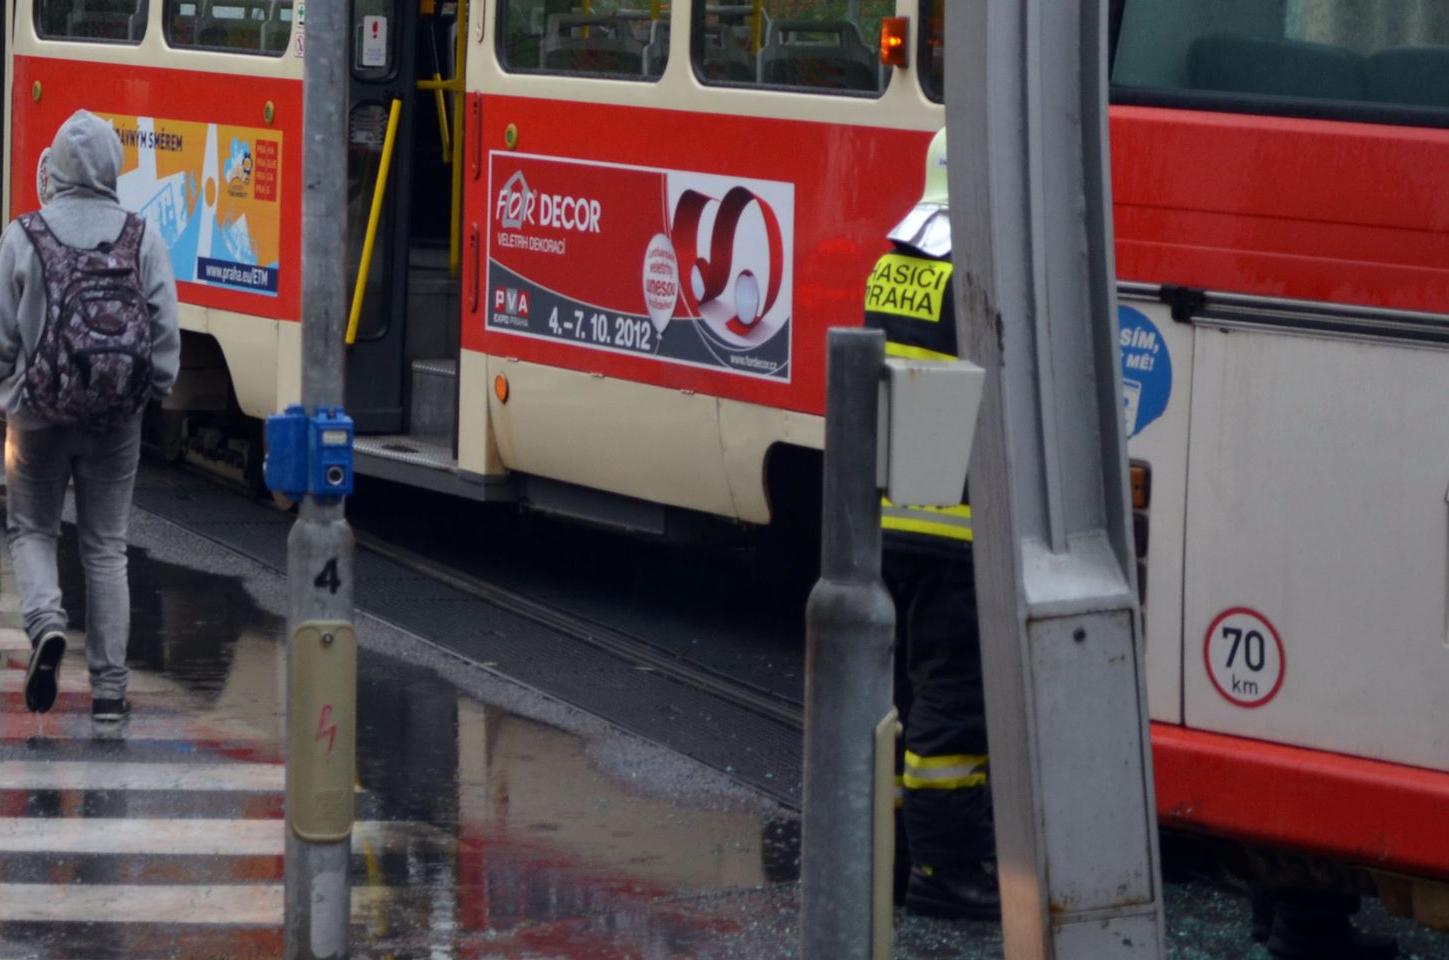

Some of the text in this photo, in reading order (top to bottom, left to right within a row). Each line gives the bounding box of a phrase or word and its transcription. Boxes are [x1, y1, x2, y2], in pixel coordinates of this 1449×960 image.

[496, 189, 601, 234] FOR DECOR
[497, 232, 566, 255] VELETRH DEKORACÍ
[872, 263, 945, 291] HASIČI
[495, 290, 529, 314] PVA
[865, 283, 934, 316] PRAHA
[590, 312, 611, 344] 10.
[614, 316, 651, 351] 2012
[1120, 326, 1159, 354] SÍM,
[313, 556, 342, 596] 4
[1222, 626, 1265, 672] 70
[1231, 673, 1258, 696] km
